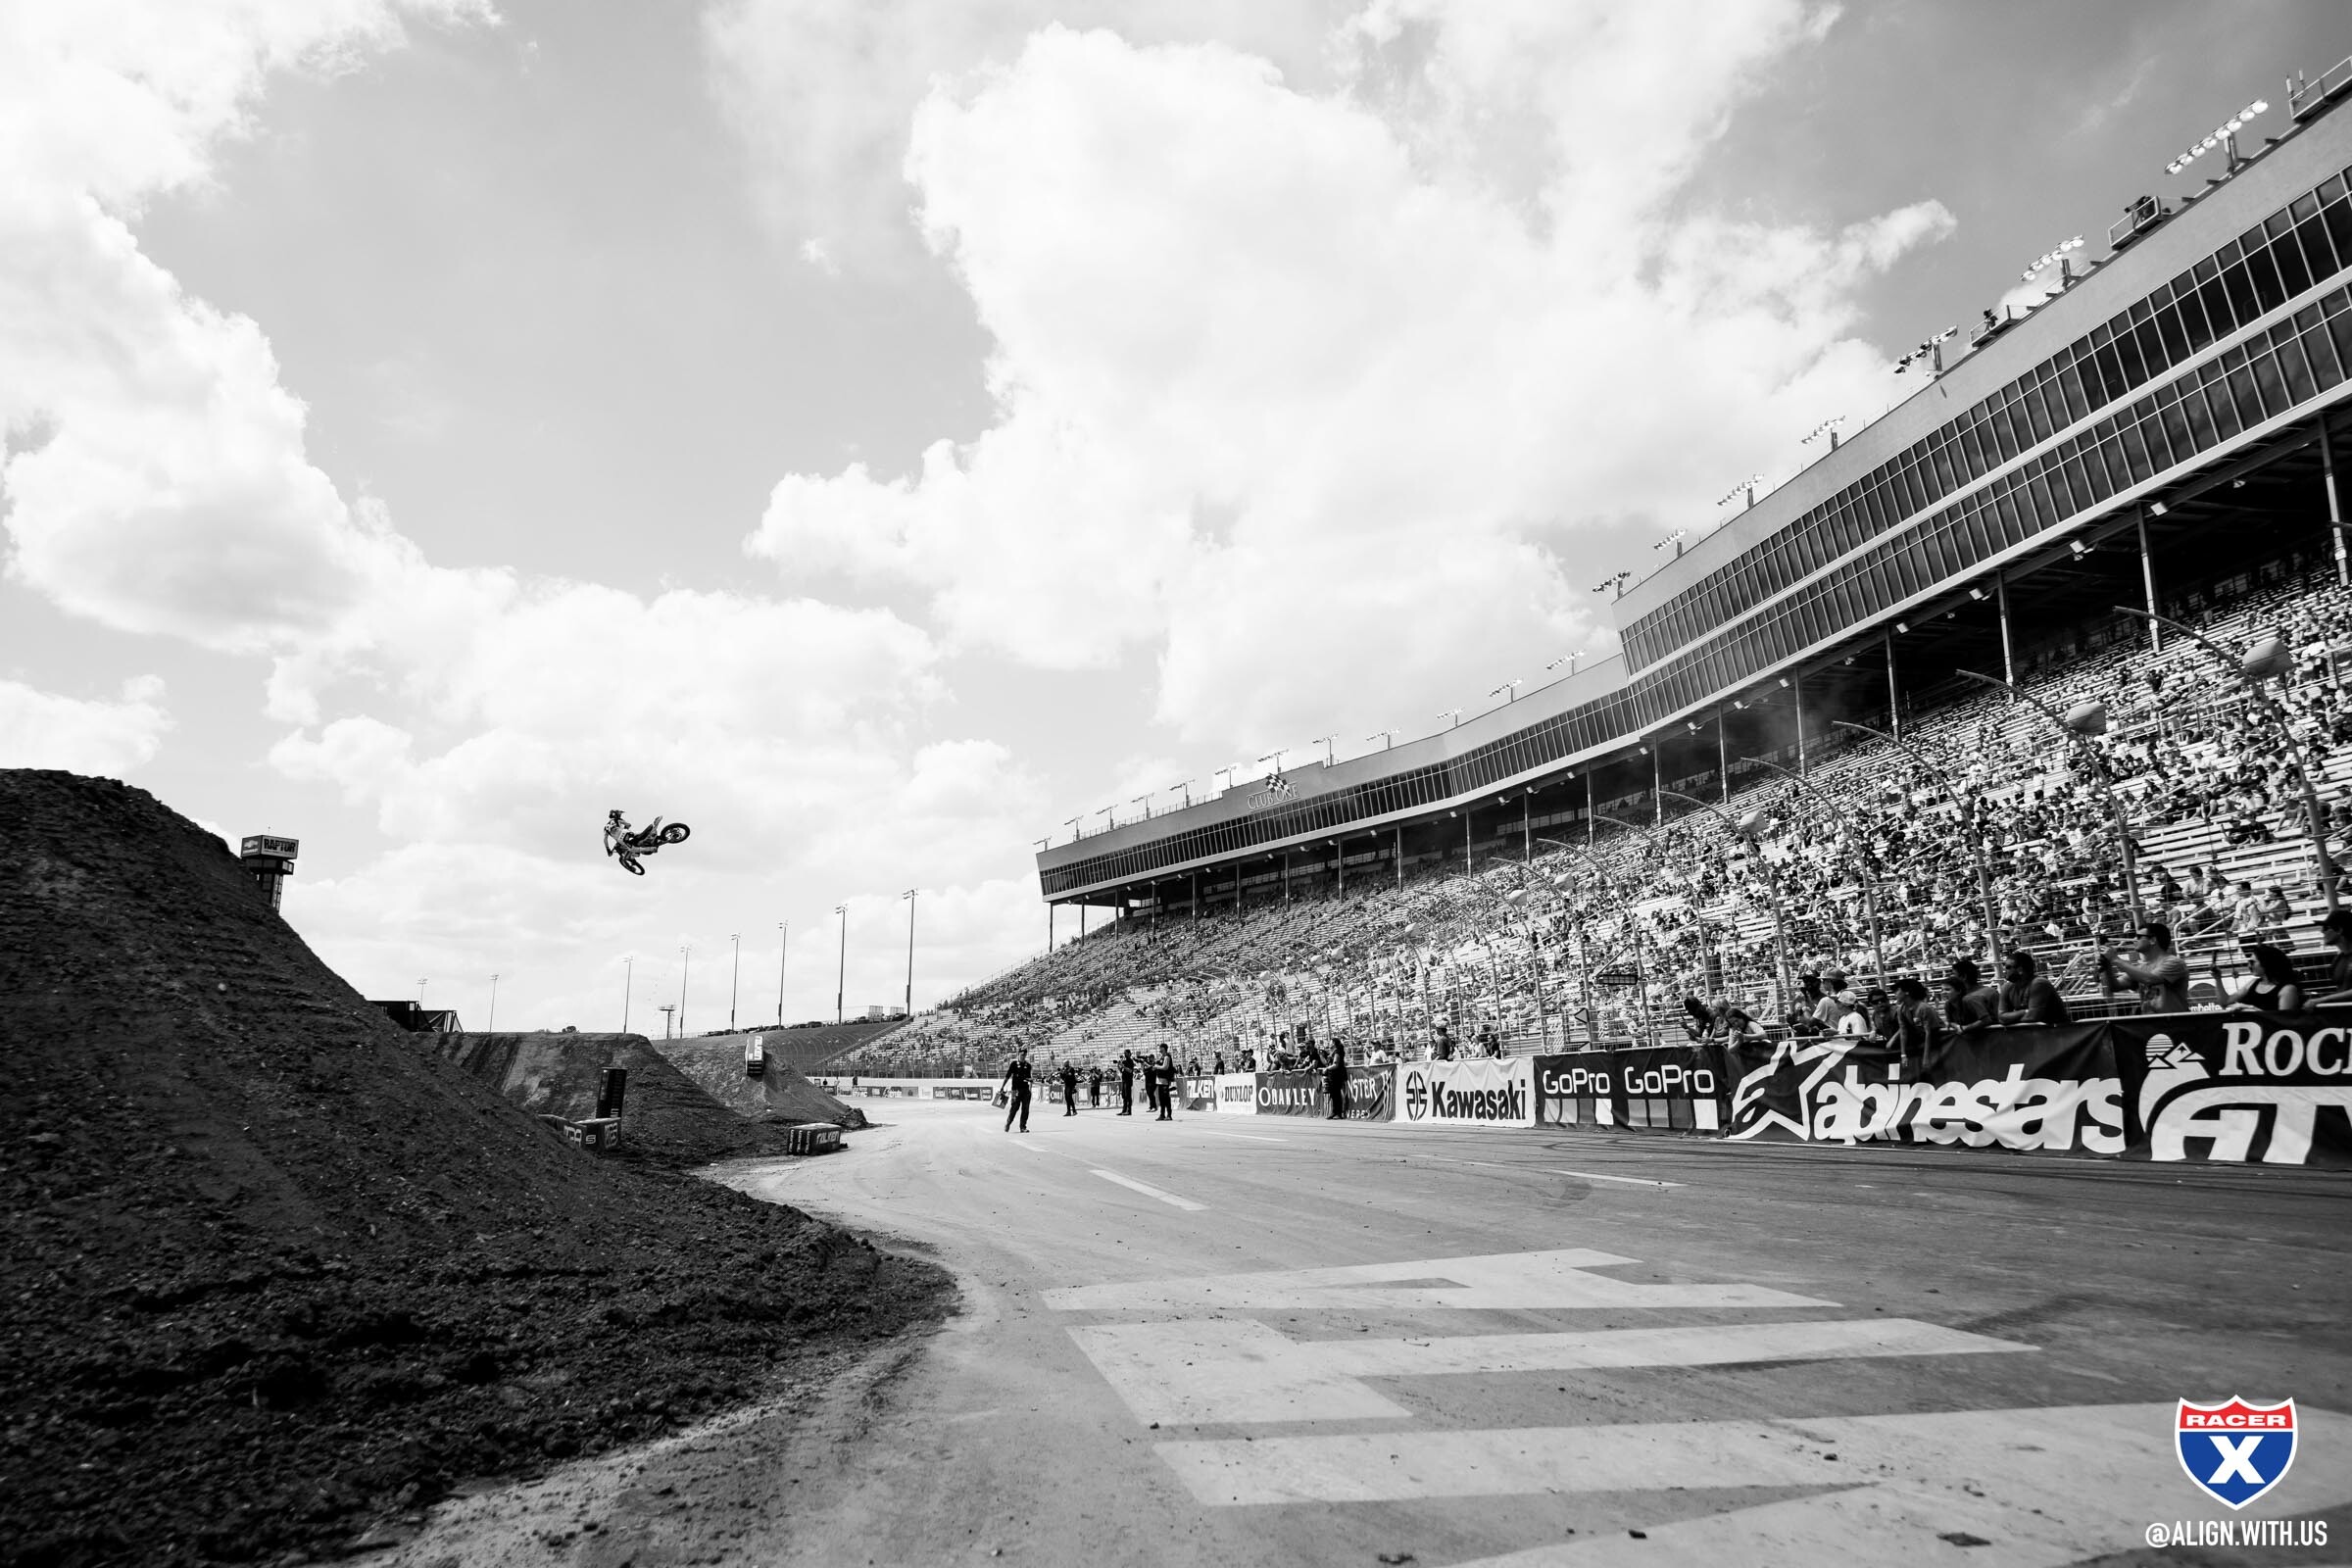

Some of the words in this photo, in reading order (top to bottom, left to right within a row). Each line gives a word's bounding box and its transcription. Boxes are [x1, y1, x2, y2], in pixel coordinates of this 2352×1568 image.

[1248, 793, 1274, 809] CLUB
[1275, 784, 1299, 802] ONE
[2219, 1021, 2352, 1077] ROC
[1224, 1084, 1253, 1102] DUNLOP
[1543, 1068, 1611, 1095] GoPro
[1625, 1064, 1715, 1095] GoPro
[1432, 1079, 1526, 1120] Kawasaki
[1813, 1063, 2127, 1154] alpinestars
